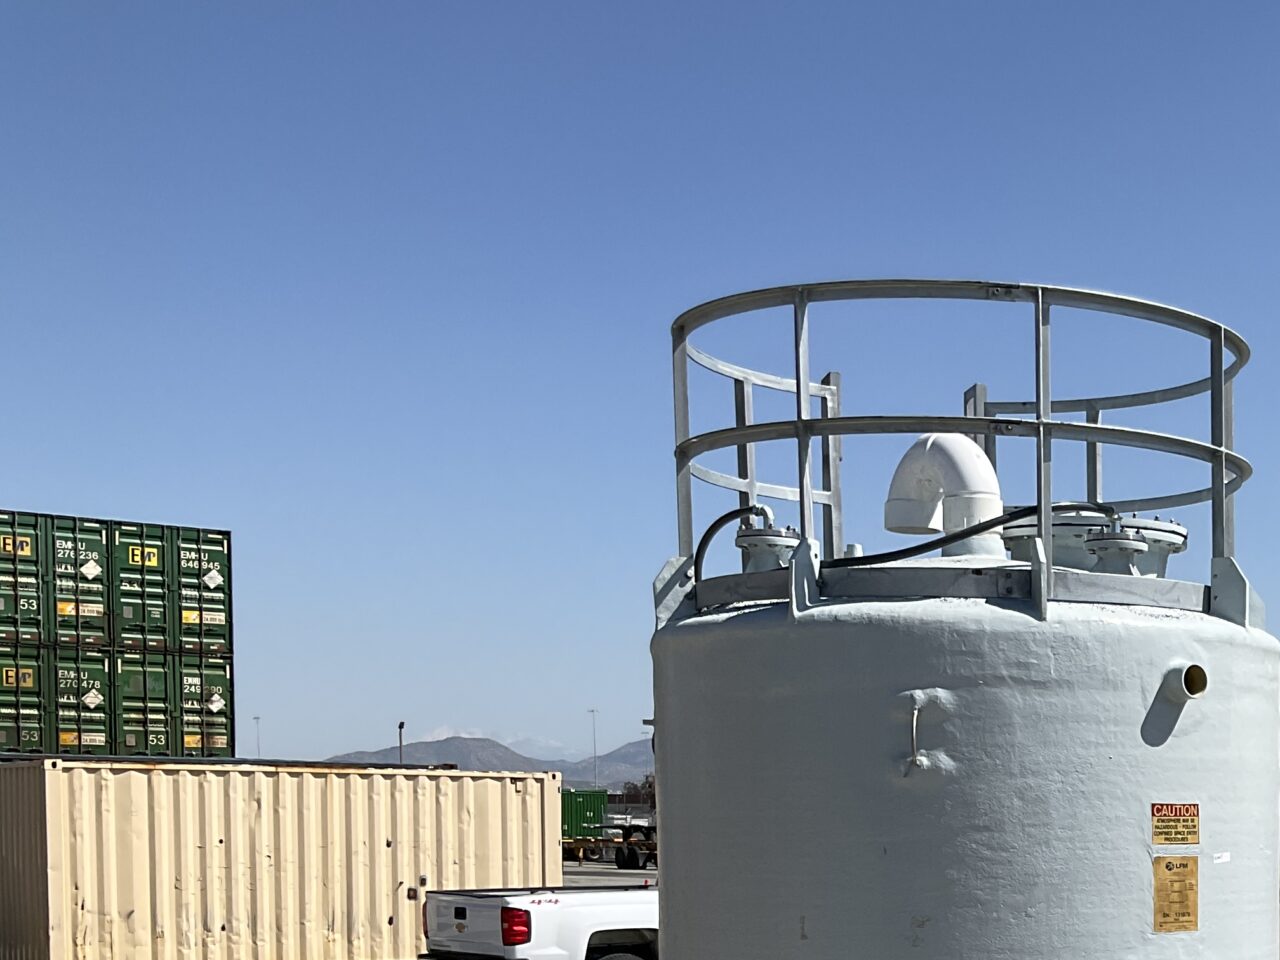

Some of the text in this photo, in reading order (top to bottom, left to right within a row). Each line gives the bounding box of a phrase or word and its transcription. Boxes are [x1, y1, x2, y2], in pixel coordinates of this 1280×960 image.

[20, 599, 38, 610] 53
[21, 731, 39, 741] 53
[149, 735, 165, 745] 53
[1153, 805, 1198, 816] CAUTION
